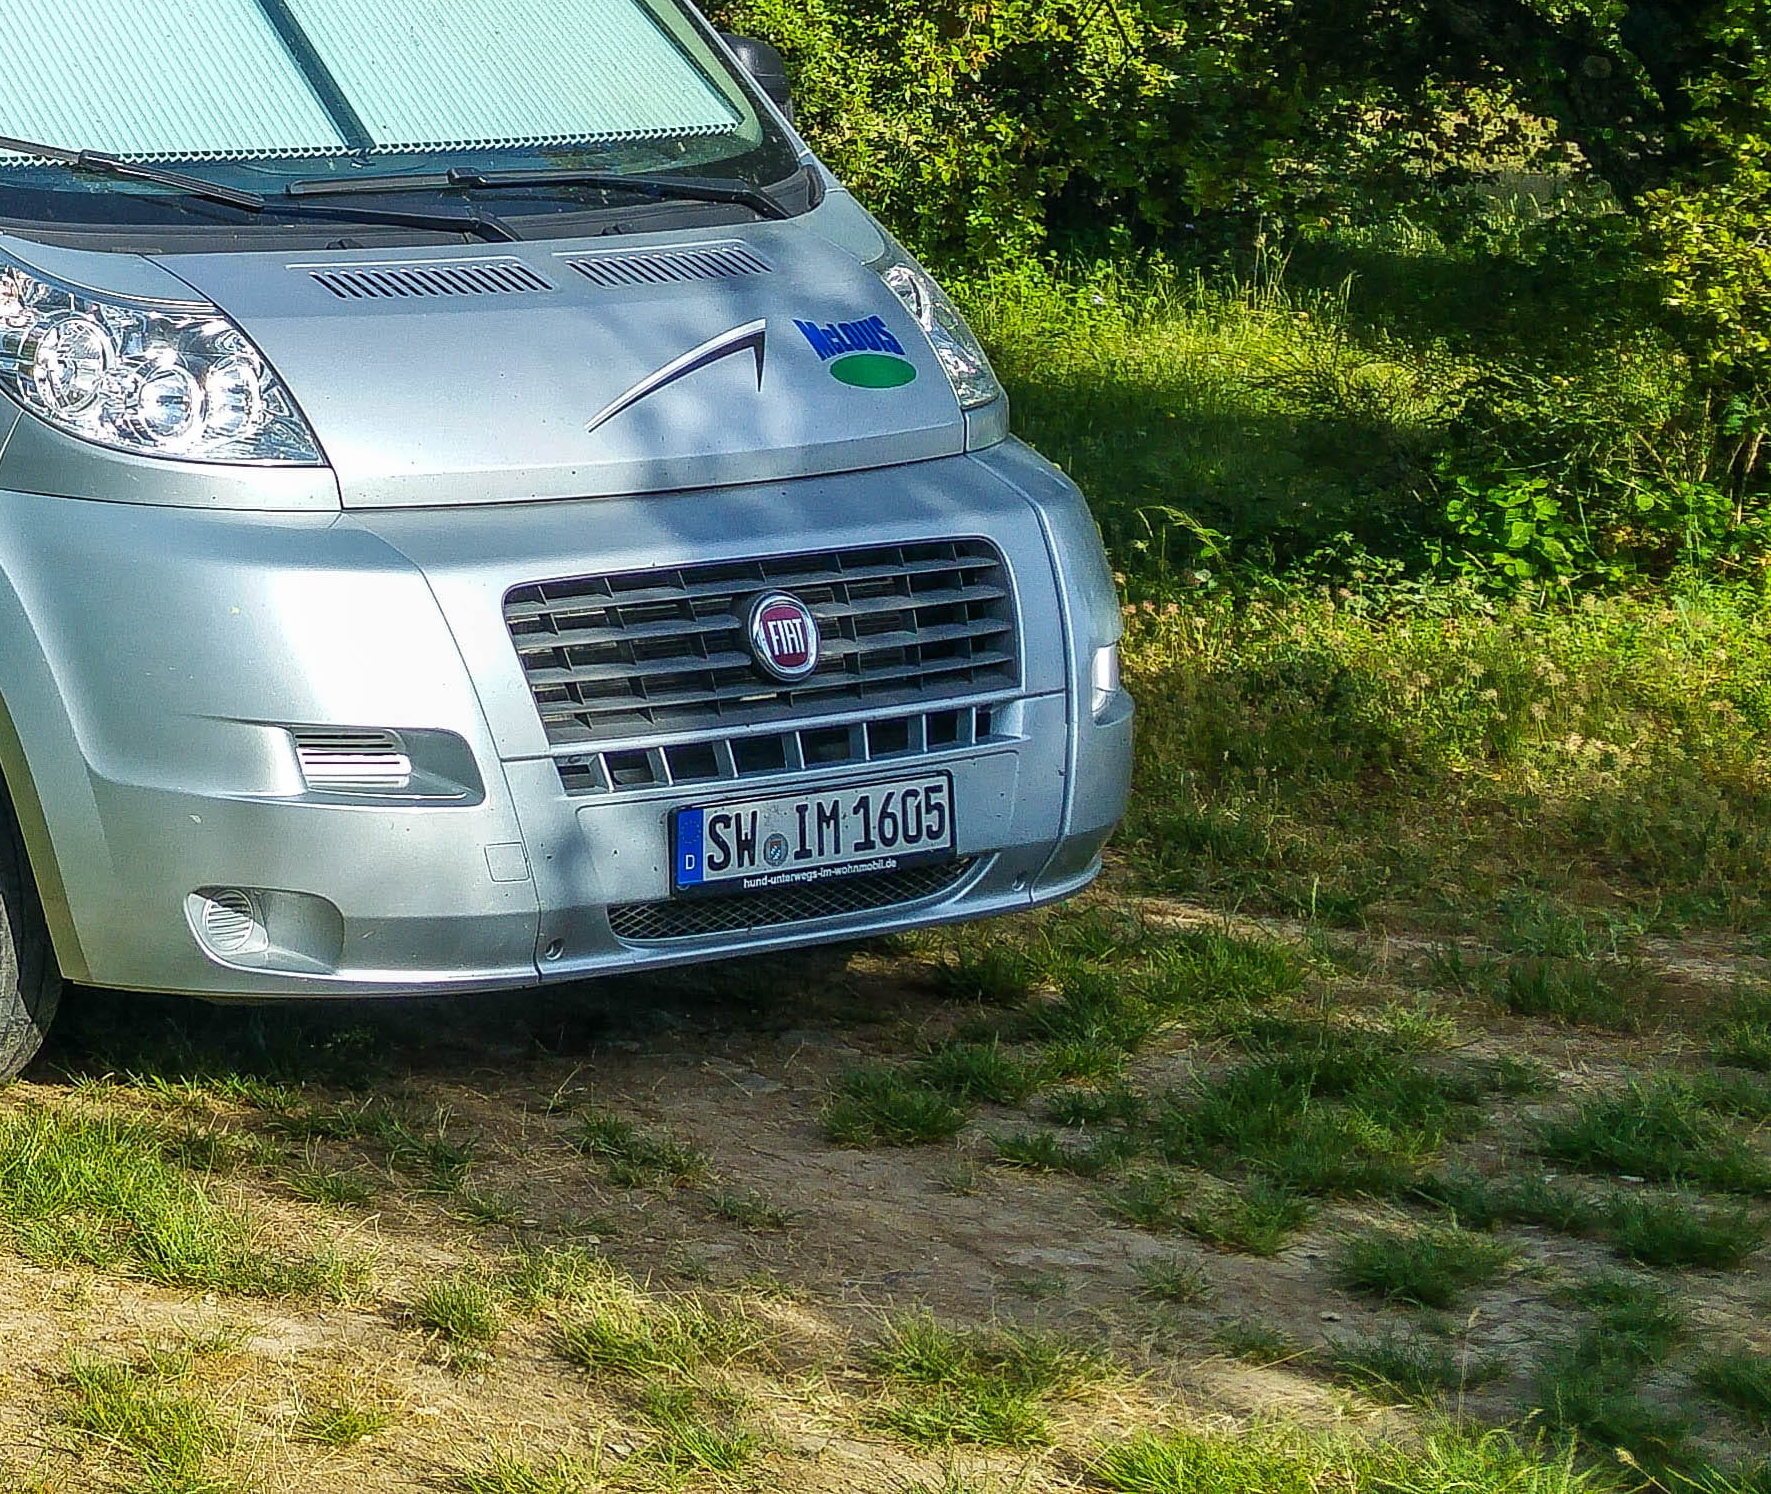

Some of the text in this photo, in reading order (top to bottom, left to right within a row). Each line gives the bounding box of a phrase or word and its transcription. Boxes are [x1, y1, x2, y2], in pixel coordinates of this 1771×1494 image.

[767, 618, 806, 656] FIAT
[685, 784, 947, 872] D SW IM 1605
[743, 857, 897, 889] hund-unterwegs-im-wohnmobil.de
